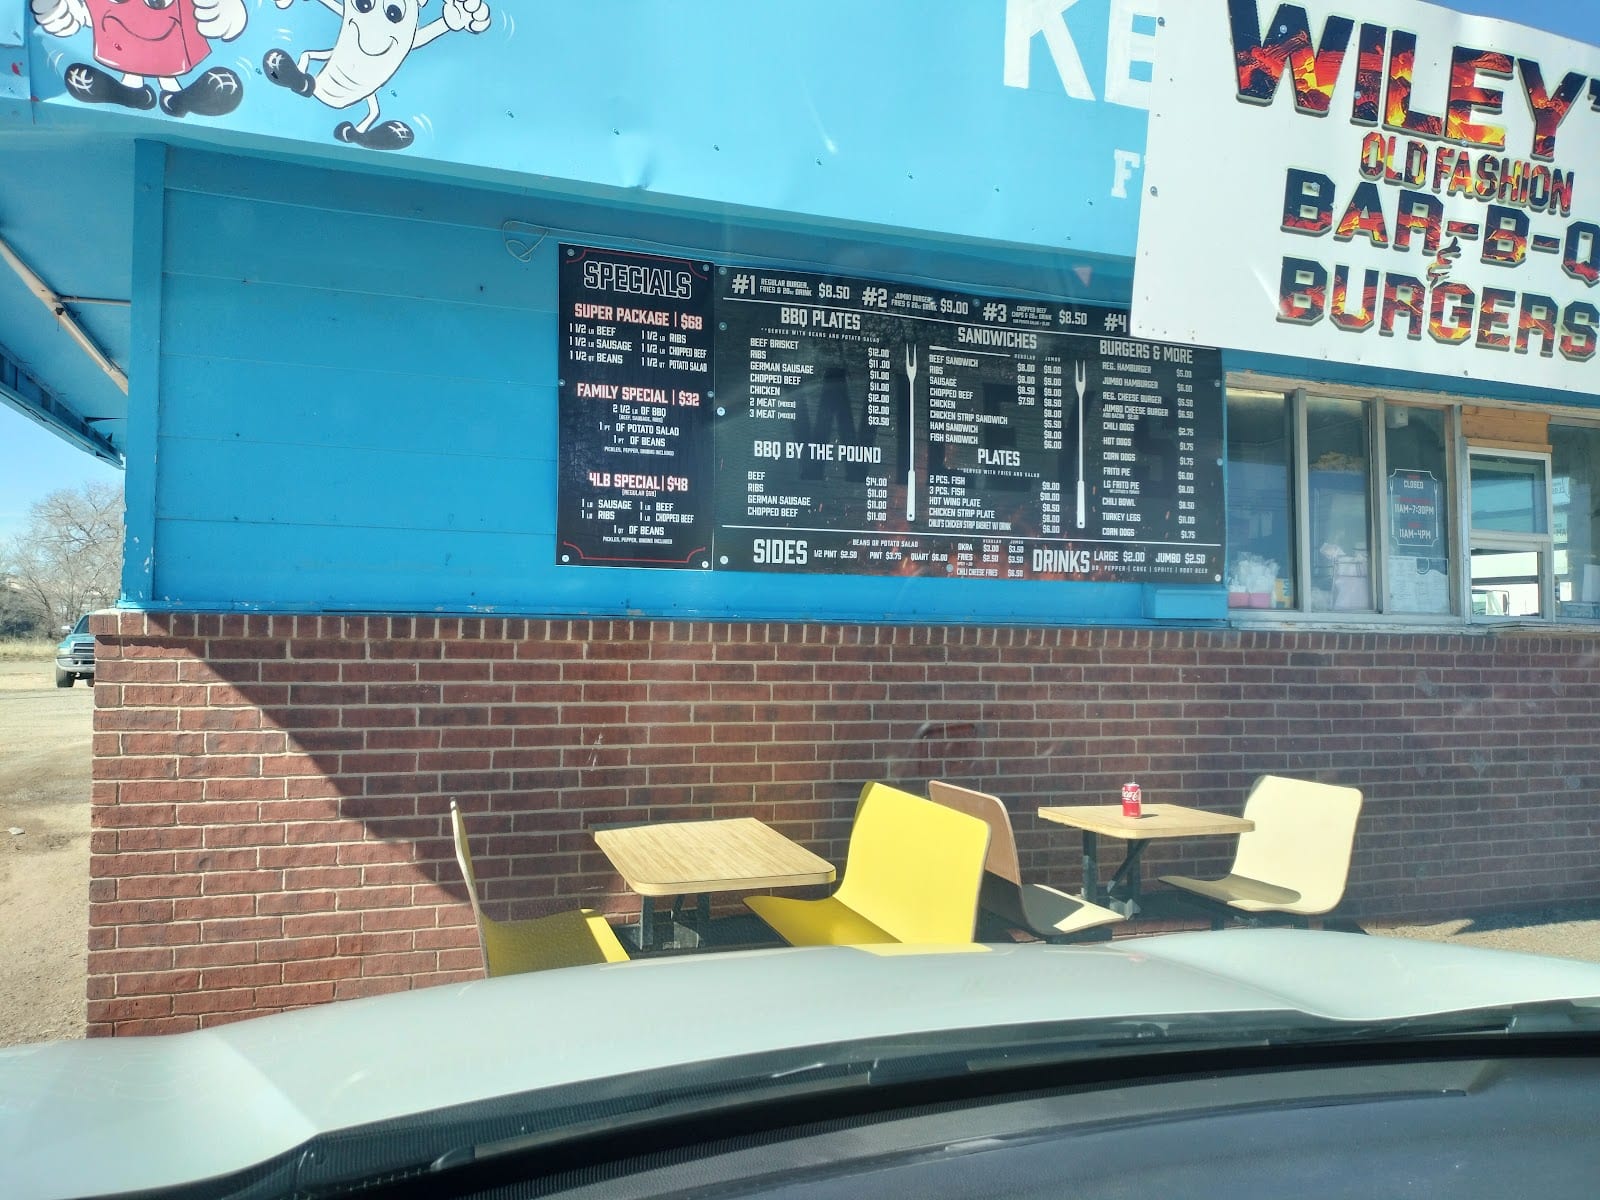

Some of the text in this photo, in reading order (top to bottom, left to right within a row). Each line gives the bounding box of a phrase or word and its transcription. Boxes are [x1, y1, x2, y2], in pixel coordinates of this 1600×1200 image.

[1111, 149, 1146, 199] F
[1359, 132, 1575, 216] OLD FASHION
[1280, 167, 1600, 287] BAR-B-Q
[584, 261, 691, 299] SPECIALS
[732, 274, 756, 295] #1
[818, 282, 850, 299] $8.50
[862, 287, 968, 314] #2 $9.00
[983, 303, 1007, 322] #3
[1058, 310, 1088, 325] $8.50
[1276, 256, 1600, 362] BURGERS
[574, 303, 702, 330] SUPER PACKAGE $68
[781, 307, 861, 330] BBQ PLATES
[1104, 313, 1126, 333] #4
[575, 324, 616, 336] 1/2 BEEF
[575, 337, 632, 351] 1/2 SAUSAGE
[669, 333, 686, 343] RIBS
[958, 327, 1037, 349] SANDWICHES
[669, 346, 707, 358] CHOPPED BEEF
[750, 338, 889, 358] BEEF BRISKET $12.00
[1100, 340, 1193, 364] BURGERS & MORE
[576, 351, 623, 364] 1/2 BEANS
[751, 350, 766, 359] RIBS
[669, 359, 707, 372] POTATO SALAD
[929, 354, 978, 368] BEEF SANDWICH
[750, 362, 814, 375] GERMAN SAUSAGE
[929, 366, 943, 375] RIBS
[1102, 362, 1151, 374] REG. HAMBURGER
[750, 373, 801, 385] CHOPPED BEEF
[929, 377, 957, 387] SAUSAGE
[1102, 377, 1158, 389] JUMBO HAMBURGER
[577, 383, 699, 407] FAMILY SPECIAL $32
[750, 385, 889, 404] CHICKEN $12.00
[930, 388, 973, 400] CHOPPED BEEF
[1102, 392, 1162, 404] REG. CHEESE BURGER
[757, 398, 889, 415] MEAT $12.00
[930, 399, 956, 409] CHICKEN
[1102, 404, 1168, 416] JUMBO CHEESE BURGER
[620, 405, 666, 418] 1/2 OF BBQ
[756, 409, 776, 419] MEAT
[930, 411, 1008, 425] CHICKEN STRIP SANDWICH
[616, 423, 679, 436] OF POTATO SALAD
[930, 422, 978, 433] HAM SANDWICH
[1103, 422, 1134, 432] CHILI DOGS
[630, 436, 665, 447] OF BEANS
[930, 433, 978, 445] FISH SANDWICH
[1103, 437, 1132, 446] HOT DOGS
[754, 440, 881, 463] BBQ BY THE POUND
[978, 448, 1020, 467] PLATES
[1104, 452, 1136, 462] CORN DOGS
[1104, 467, 1131, 476] FRITO PIE
[589, 472, 688, 492] 4LB SPECIAL $48
[748, 471, 887, 487] BEEF $14.00
[936, 475, 965, 486] PCS. FISH
[1404, 480, 1423, 488] CLOSED
[748, 483, 887, 498] RIBS $11.00
[936, 487, 965, 496] PCS. FISH
[1112, 481, 1140, 490] FRITO PIE
[598, 500, 632, 510] SAUSAGE
[656, 502, 674, 511] BEEF
[748, 495, 887, 510] GERMAN SAUSAGE $11.00
[929, 498, 981, 508] HOT WING PLATE
[1102, 497, 1136, 507] CHILI BOWL
[598, 511, 615, 520] RIBS
[656, 513, 694, 523] CHOPPED BEEF
[748, 507, 798, 518] CHOPPED BEEF
[929, 508, 995, 519] CHICKEN STRIP PLATE
[1102, 512, 1141, 522] TURKEY LEGS
[629, 526, 664, 536] OF BEANS
[1102, 528, 1135, 537] CORN DOGS
[753, 538, 808, 564] SIDES
[958, 542, 973, 551] OKRA
[911, 552, 928, 561] QUART
[958, 553, 973, 562] FRIES
[1032, 549, 1090, 573] DRINKS
[1094, 551, 1145, 562] LARGE $2.00
[1156, 552, 1206, 564] JUMBO $2.50
